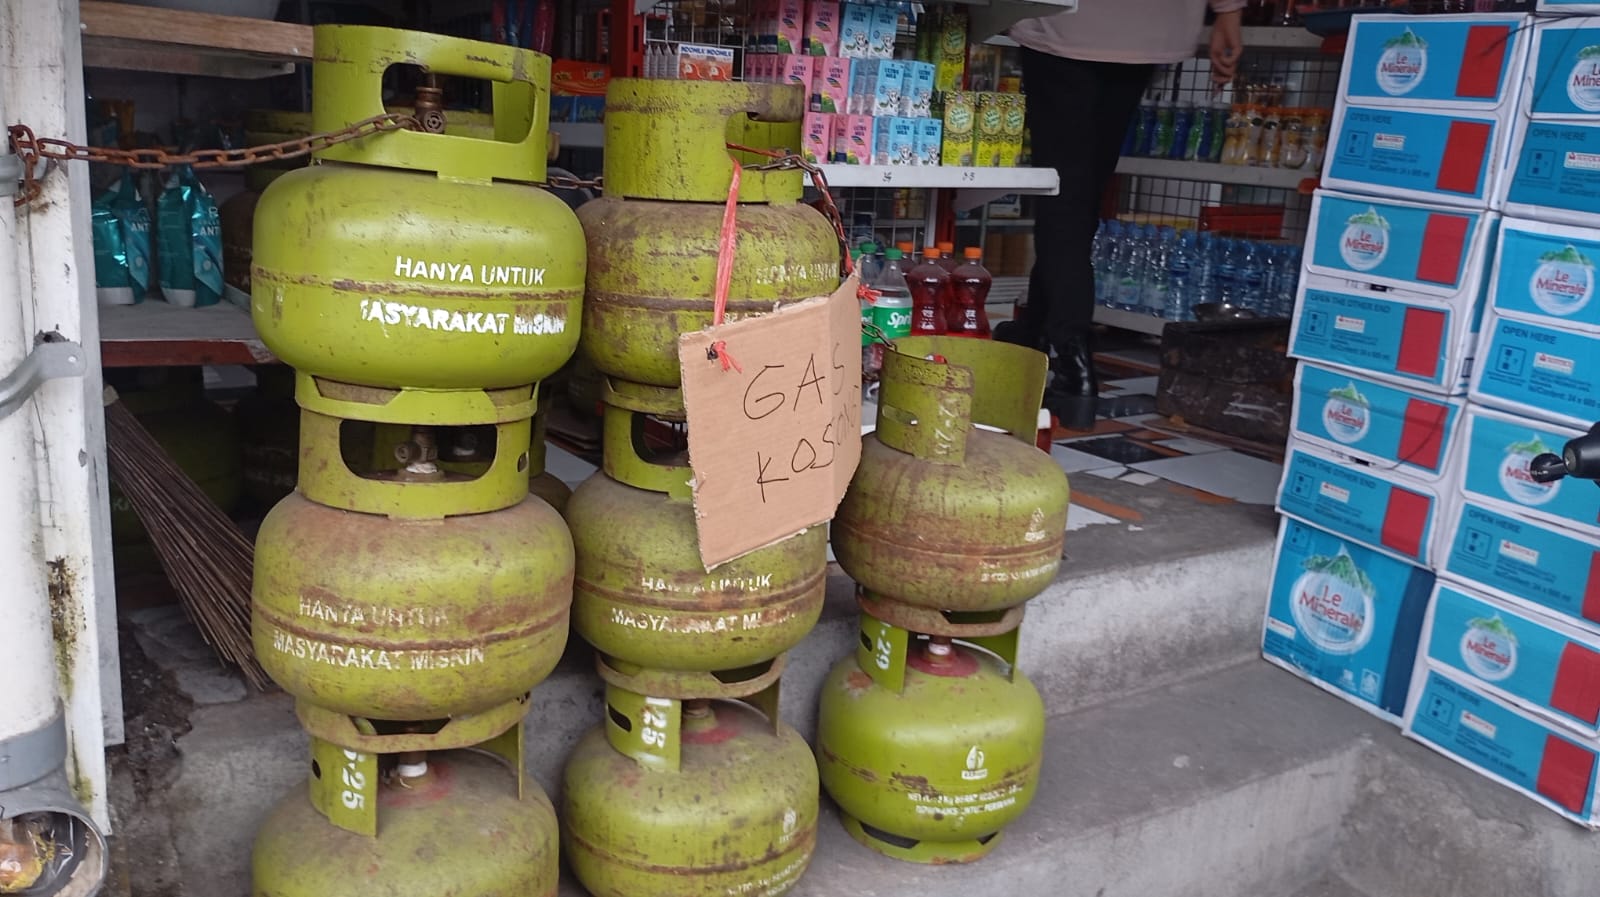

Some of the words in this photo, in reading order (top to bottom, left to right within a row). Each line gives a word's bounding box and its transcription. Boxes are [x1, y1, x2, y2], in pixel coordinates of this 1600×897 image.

[1396, 52, 1408, 64] Le
[1380, 62, 1420, 74] Minerale
[1350, 113, 1369, 122] OPEN
[1372, 115, 1392, 124] HERE
[1532, 128, 1557, 138] OPEN
[1560, 131, 1585, 141] HERE
[1360, 230, 1372, 241] Le
[1346, 237, 1384, 253] Minerale
[394, 256, 474, 284] HANYA
[481, 265, 546, 286] UNTUK
[1555, 270, 1569, 282] Le
[1536, 278, 1586, 296] Minerale
[1310, 293, 1330, 303] OPEN
[1332, 297, 1345, 306] THE
[1347, 299, 1372, 310] OTHER
[1374, 304, 1391, 313] END
[1502, 326, 1528, 338] OPEN
[1530, 332, 1557, 344] HERE
[744, 342, 845, 421] GAS
[1342, 404, 1352, 415] Le
[1468, 510, 1494, 524] OPEN
[1495, 519, 1521, 534] HERE
[1322, 585, 1342, 606] Le
[1299, 591, 1364, 633] Minerale
[1484, 636, 1496, 649] Le
